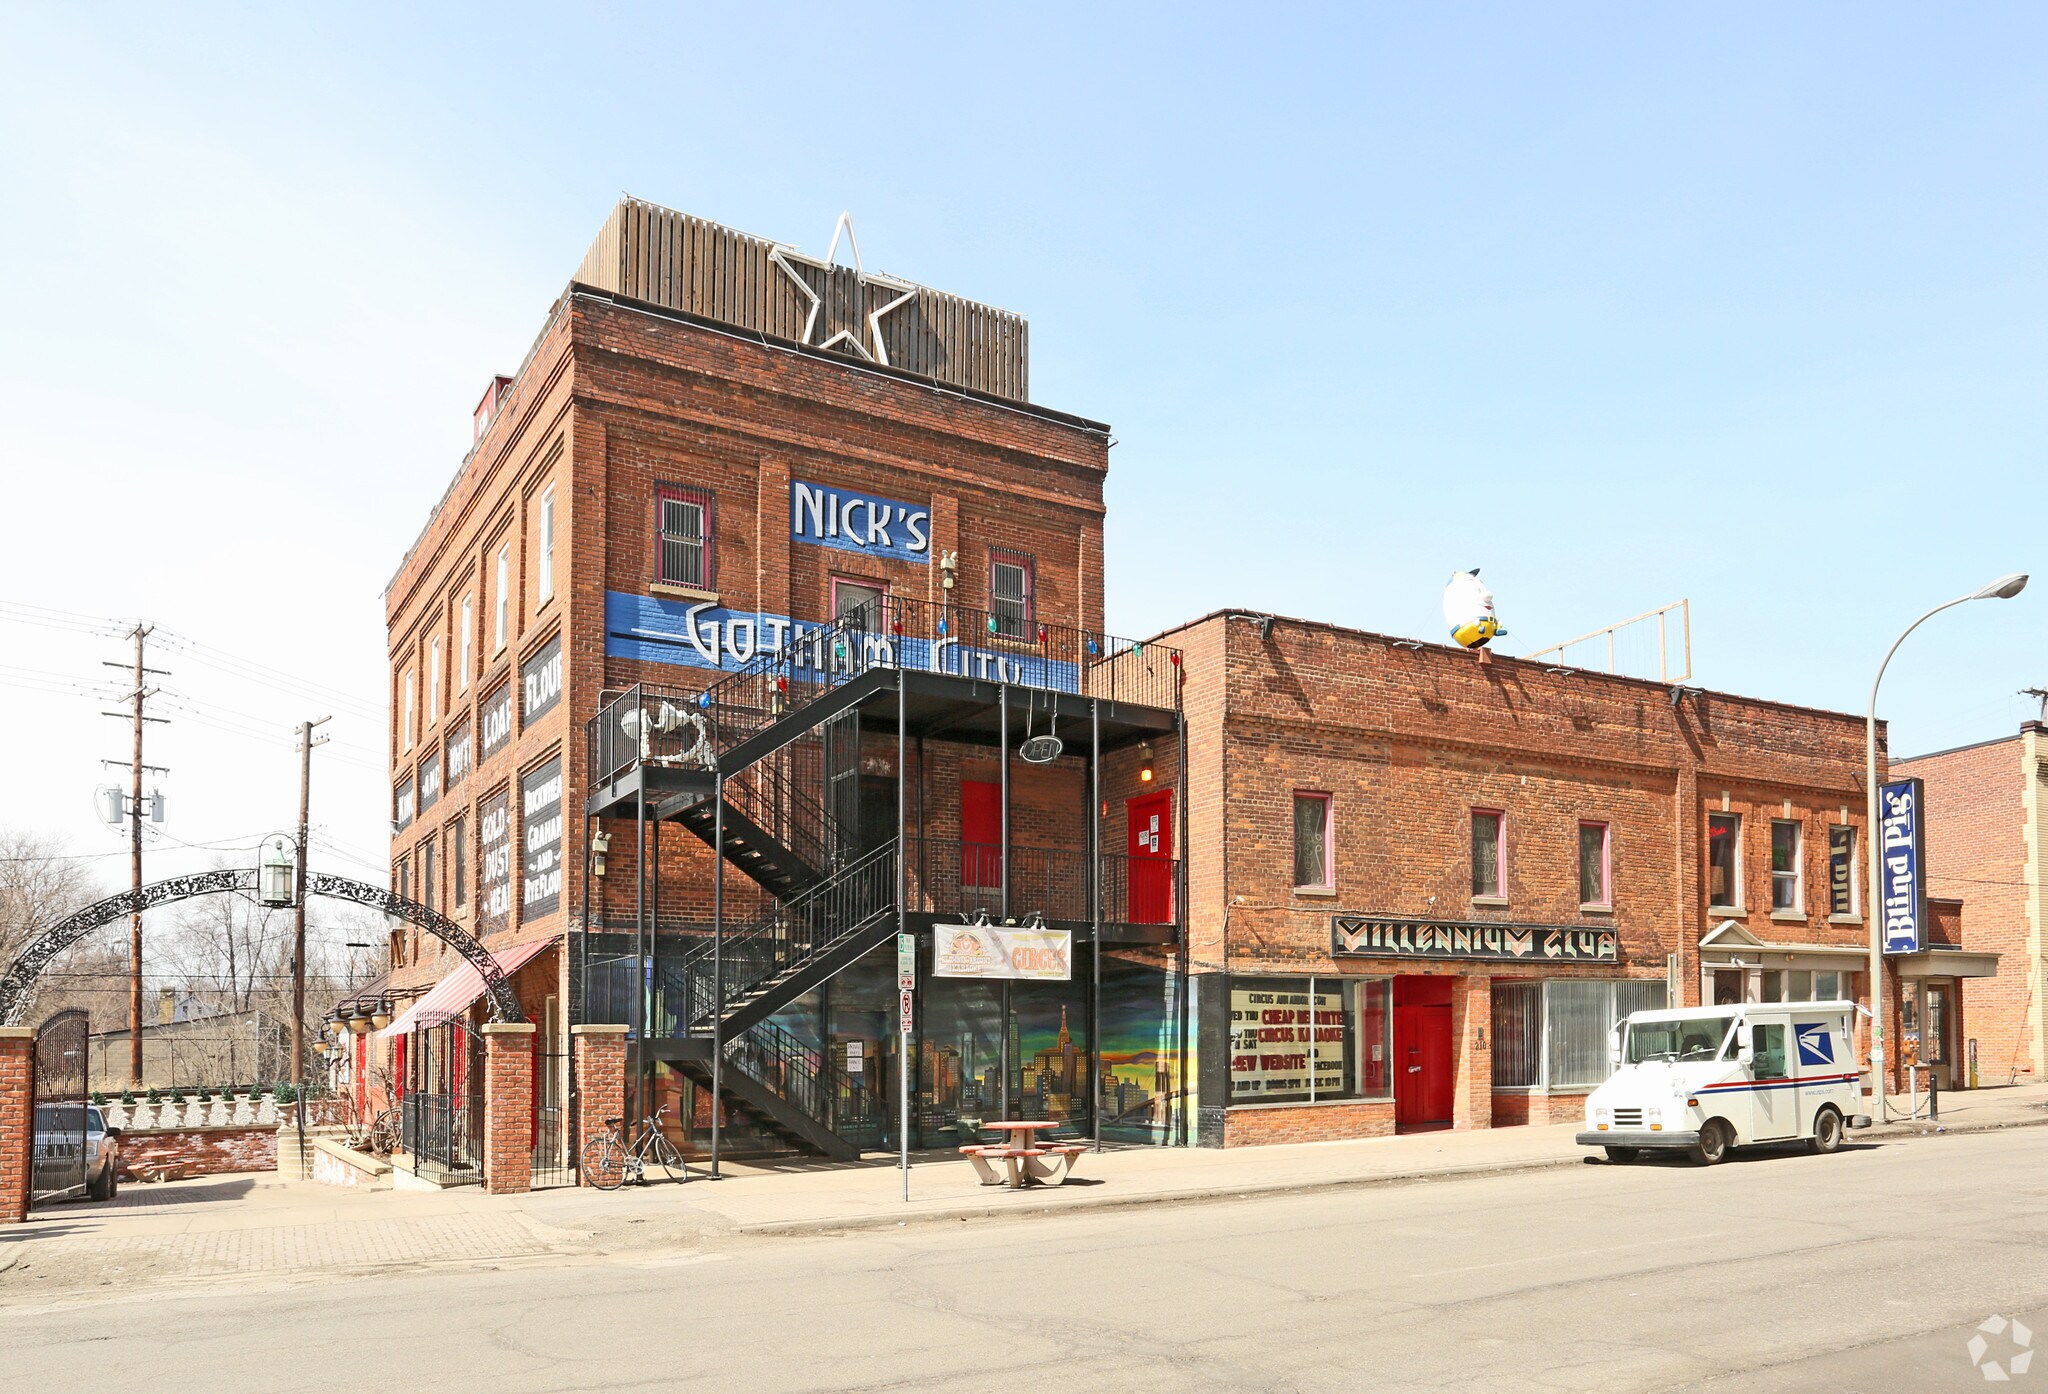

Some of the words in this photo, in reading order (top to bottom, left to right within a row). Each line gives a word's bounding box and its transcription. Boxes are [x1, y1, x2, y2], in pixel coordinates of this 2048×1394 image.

[795, 482, 929, 552] NICK'S
[1023, 739, 1060, 760] OPEN
[524, 774, 562, 818] BUCKWHEA
[482, 807, 505, 846] GOLD
[1884, 791, 1913, 854] Pig
[485, 842, 511, 884] DUST
[537, 848, 553, 873] AND
[539, 868, 561, 900] FLOU
[1886, 853, 1916, 943] Blind
[1338, 921, 1533, 958] MILLENNIUM
[1543, 929, 1616, 959] CLUB
[1011, 946, 1067, 971] CIRCUS
[1249, 993, 1274, 1004] CIRCUS
[1244, 1011, 1258, 1021] THU
[1262, 1009, 1295, 1025] CHEAP
[1297, 1010, 1320, 1025] BER
[1243, 1039, 1258, 1049] SAT
[1258, 1027, 1295, 1043] CIRCUS
[1475, 1040, 1486, 1051] 210
[1260, 1054, 1306, 1071] WEBSITE
[1306, 1048, 1319, 1059] AD
